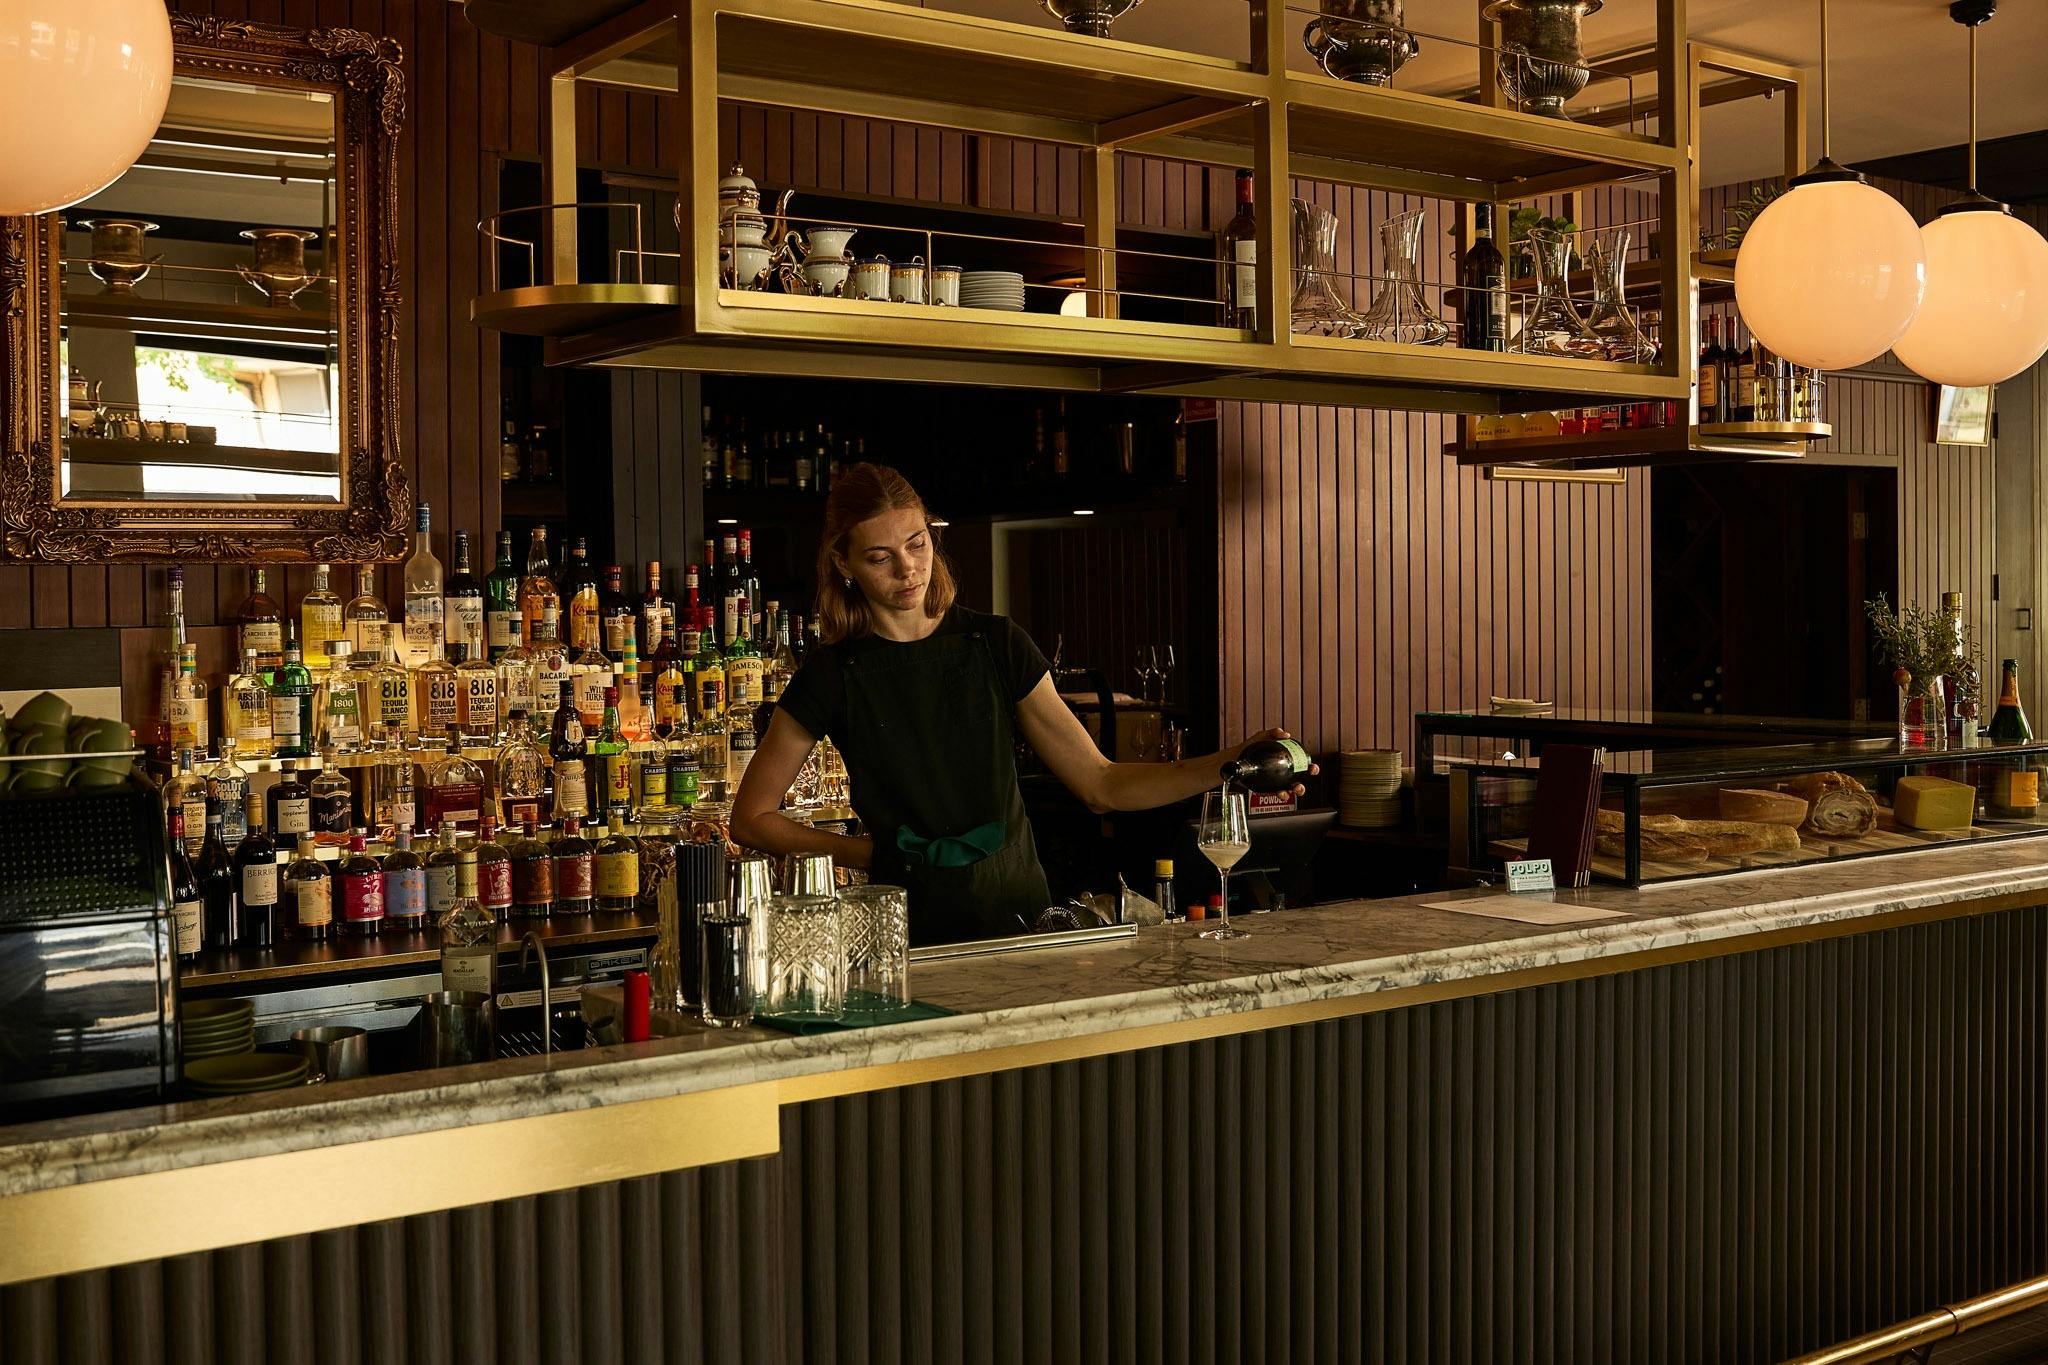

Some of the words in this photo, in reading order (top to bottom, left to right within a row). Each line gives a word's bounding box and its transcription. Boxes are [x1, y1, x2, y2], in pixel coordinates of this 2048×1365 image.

[381, 681, 408, 698] 818
[430, 682, 456, 699] 818
[470, 679, 495, 696] 818
[333, 699, 354, 708] 1800
[381, 699, 408, 707] TEQUILA
[430, 700, 456, 708] TEQUILA
[470, 697, 495, 705] TEQUILA
[381, 706, 408, 715] BLANCO
[430, 707, 457, 716] REPOSADO
[470, 704, 495, 712] AÑEJO
[1510, 862, 1550, 876] POLPO
